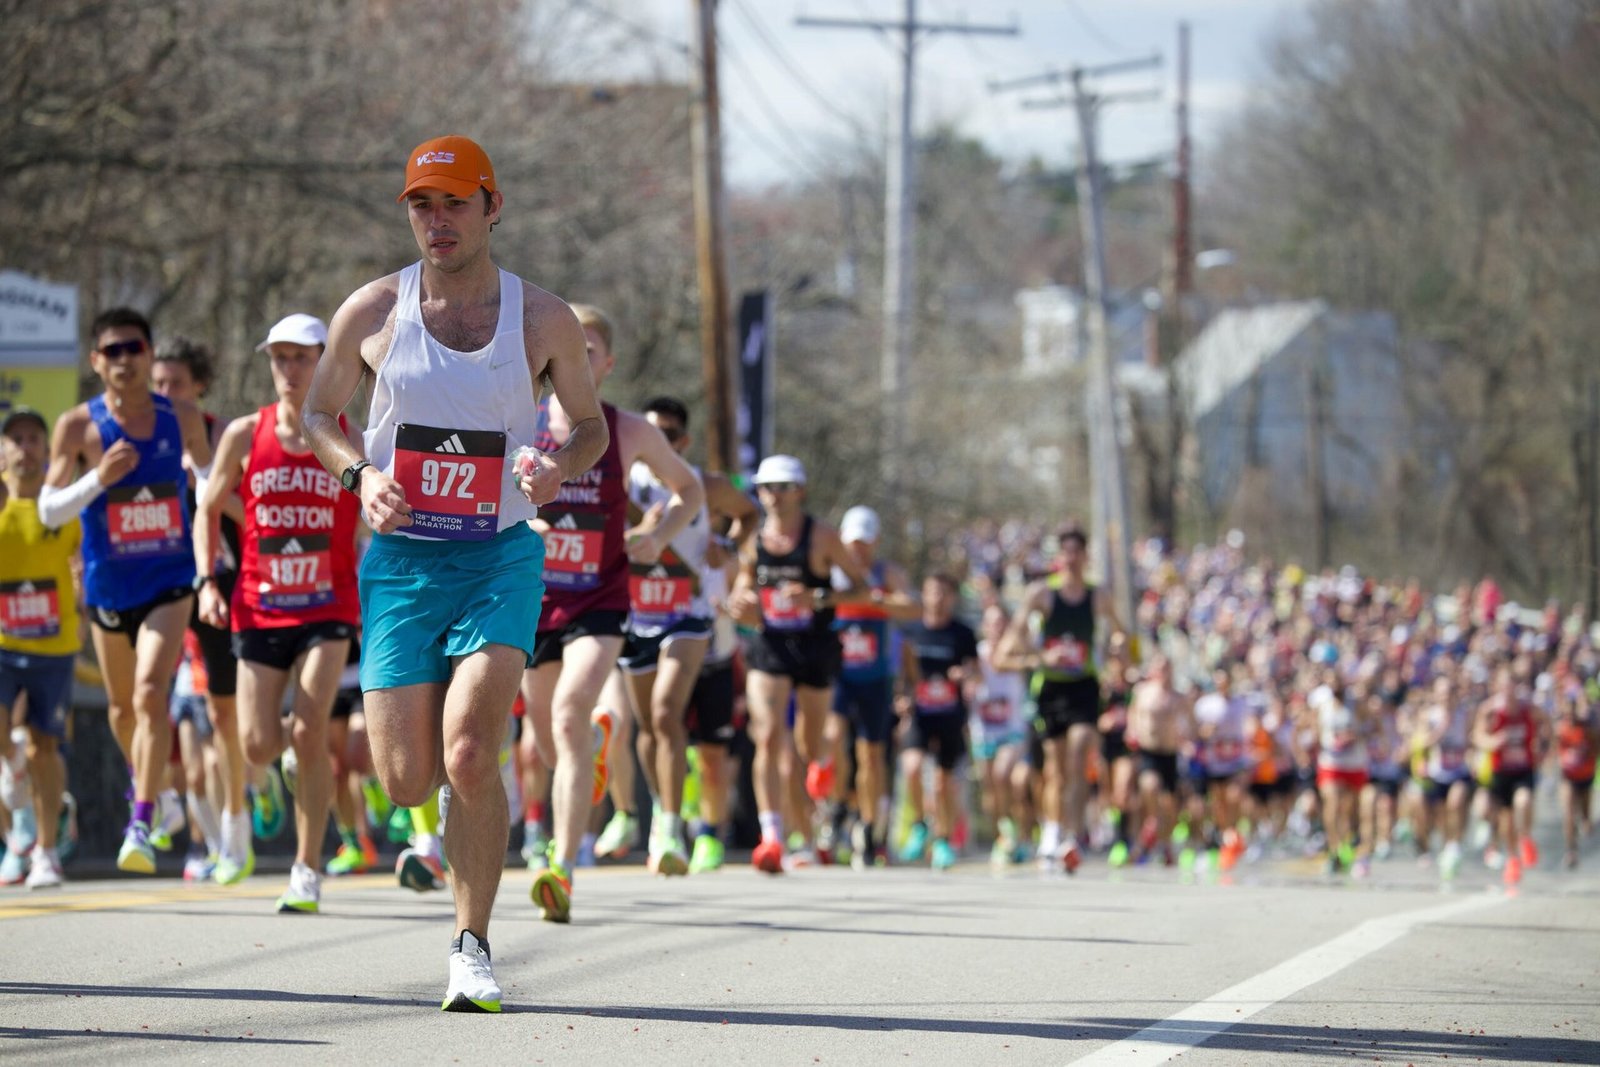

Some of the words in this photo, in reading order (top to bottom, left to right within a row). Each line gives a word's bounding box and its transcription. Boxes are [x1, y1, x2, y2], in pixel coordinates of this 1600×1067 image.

[251, 467, 342, 502] GREATER
[421, 459, 477, 499] 972
[256, 504, 335, 529] BOSTON
[415, 519, 462, 531] MARATHON
[431, 515, 463, 524] BOSTON
[545, 532, 586, 563] 575
[268, 555, 320, 585] 1877
